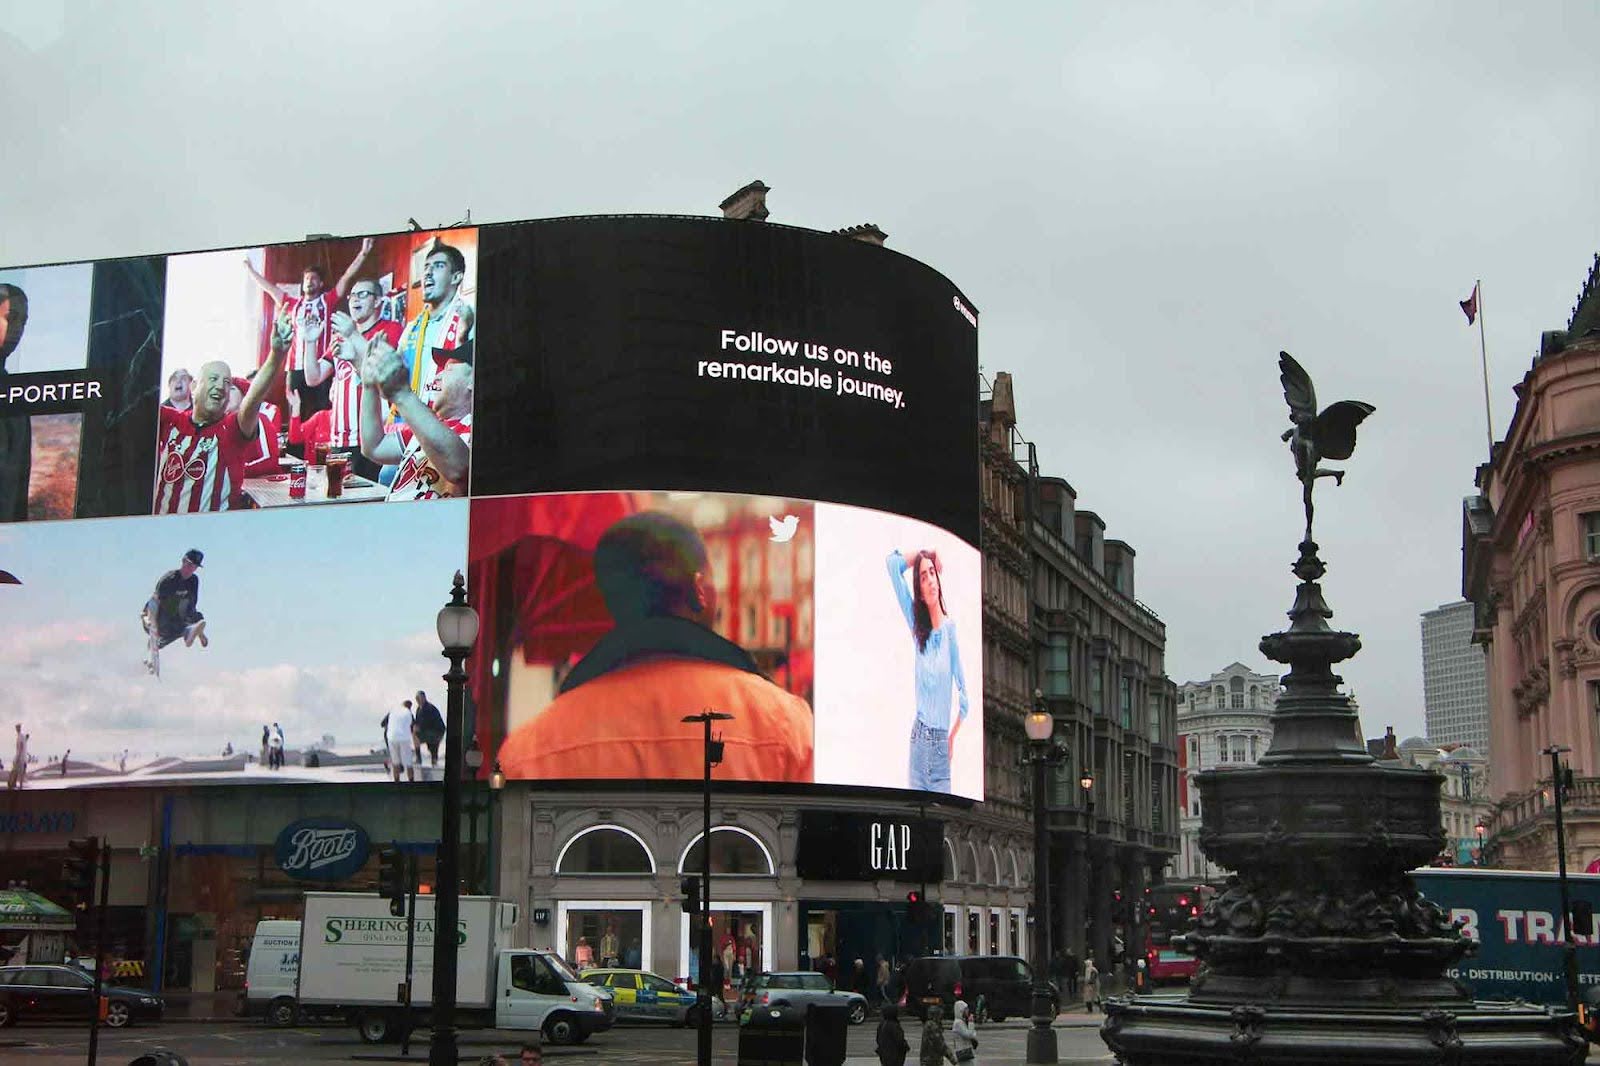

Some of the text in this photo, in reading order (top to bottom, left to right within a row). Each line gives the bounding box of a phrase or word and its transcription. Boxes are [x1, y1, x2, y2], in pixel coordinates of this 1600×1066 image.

[721, 329, 893, 375] Follow us on the
[697, 361, 906, 409] remarkable journey.
[283, 829, 357, 870] Boots
[871, 823, 911, 870] GAP
[264, 939, 293, 947] SUCTION
[1469, 968, 1553, 982] DISTRIBUTION
